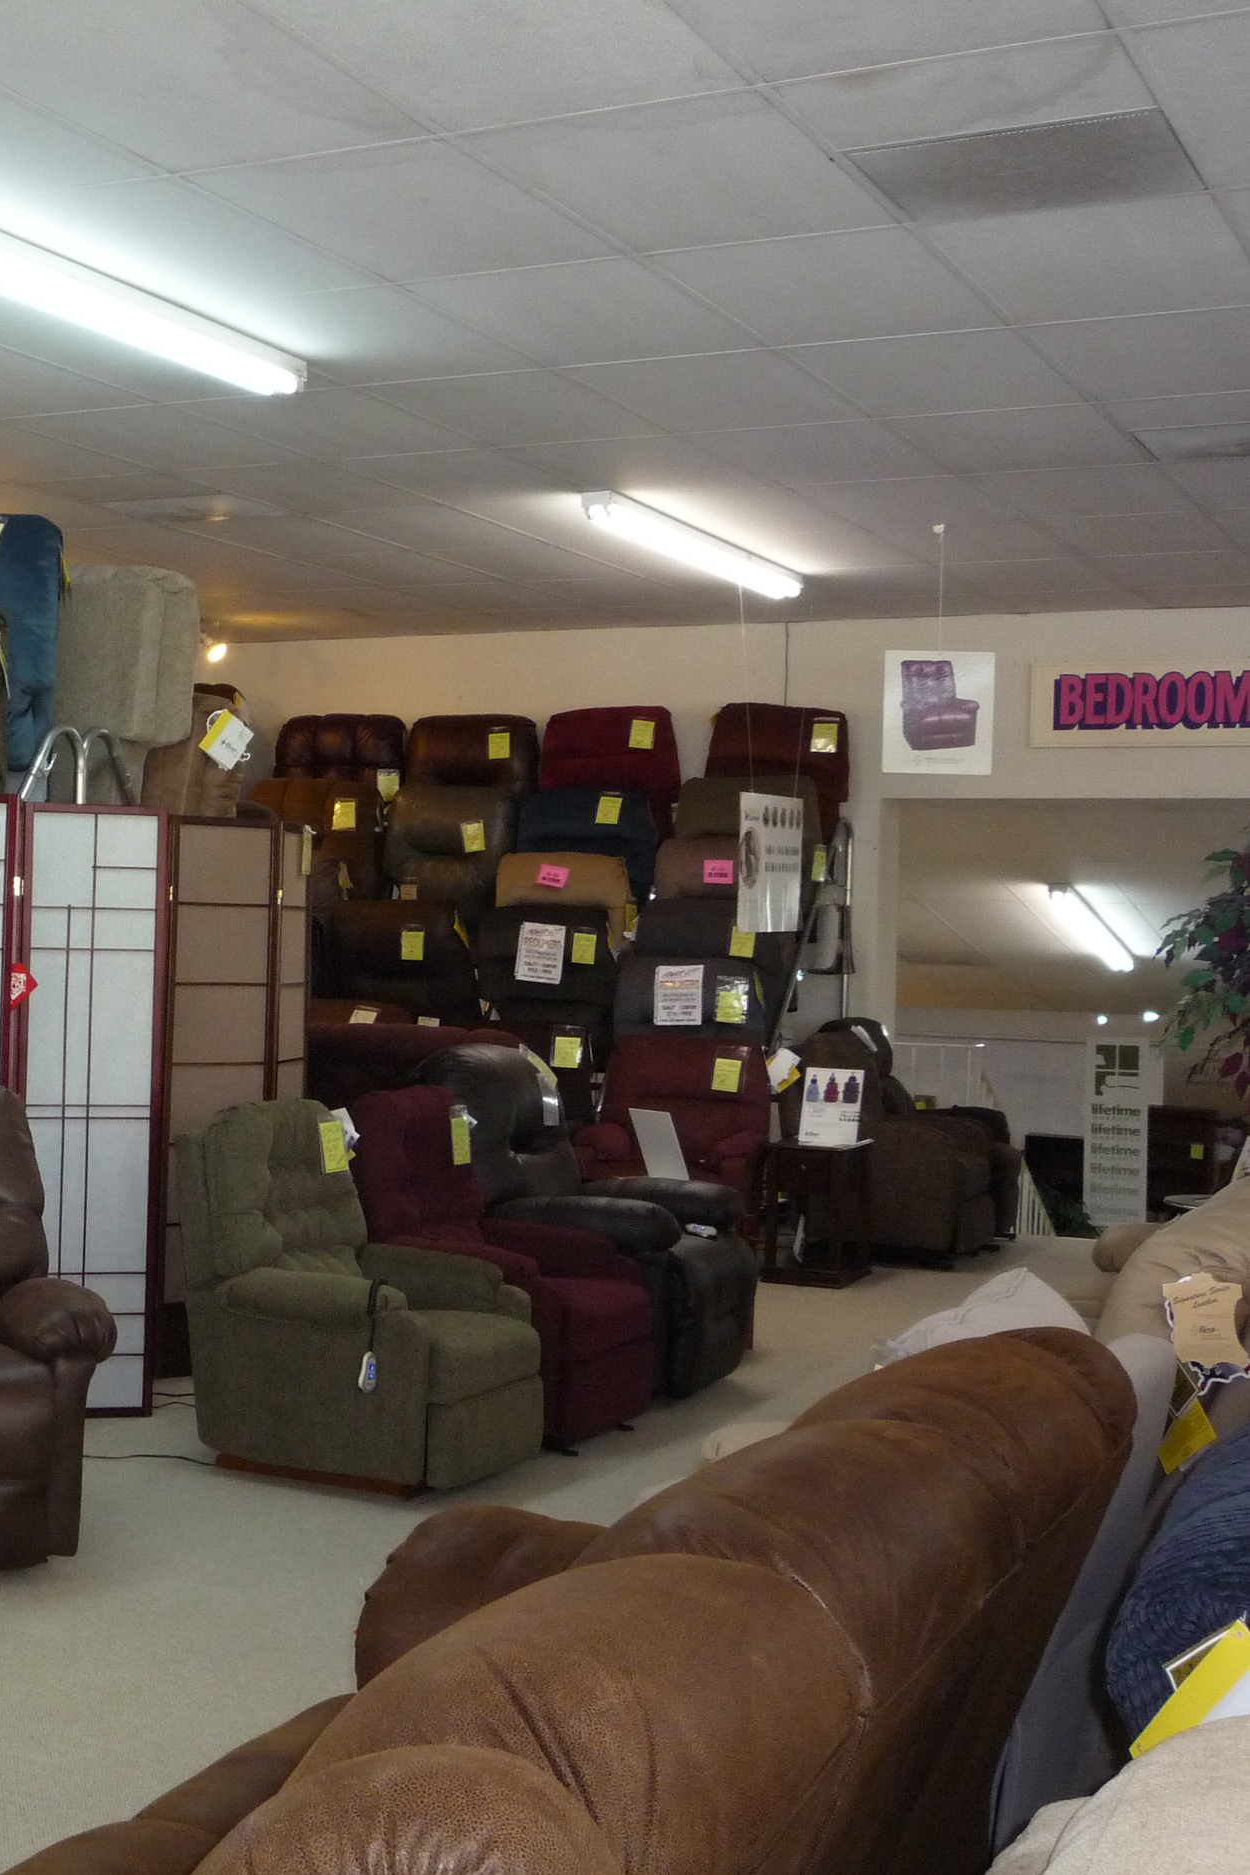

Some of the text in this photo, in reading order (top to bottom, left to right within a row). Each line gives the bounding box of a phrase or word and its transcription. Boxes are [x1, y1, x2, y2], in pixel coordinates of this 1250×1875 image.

[1053, 671, 1250, 730] BEDROOM
[1091, 1103, 1141, 1116] lifetime
[1091, 1122, 1141, 1136] lifetime
[1091, 1142, 1140, 1156] lifetime
[1090, 1163, 1140, 1176] lifetime
[1173, 1292, 1207, 1305] Signature
[1191, 1298, 1218, 1309] Leather
